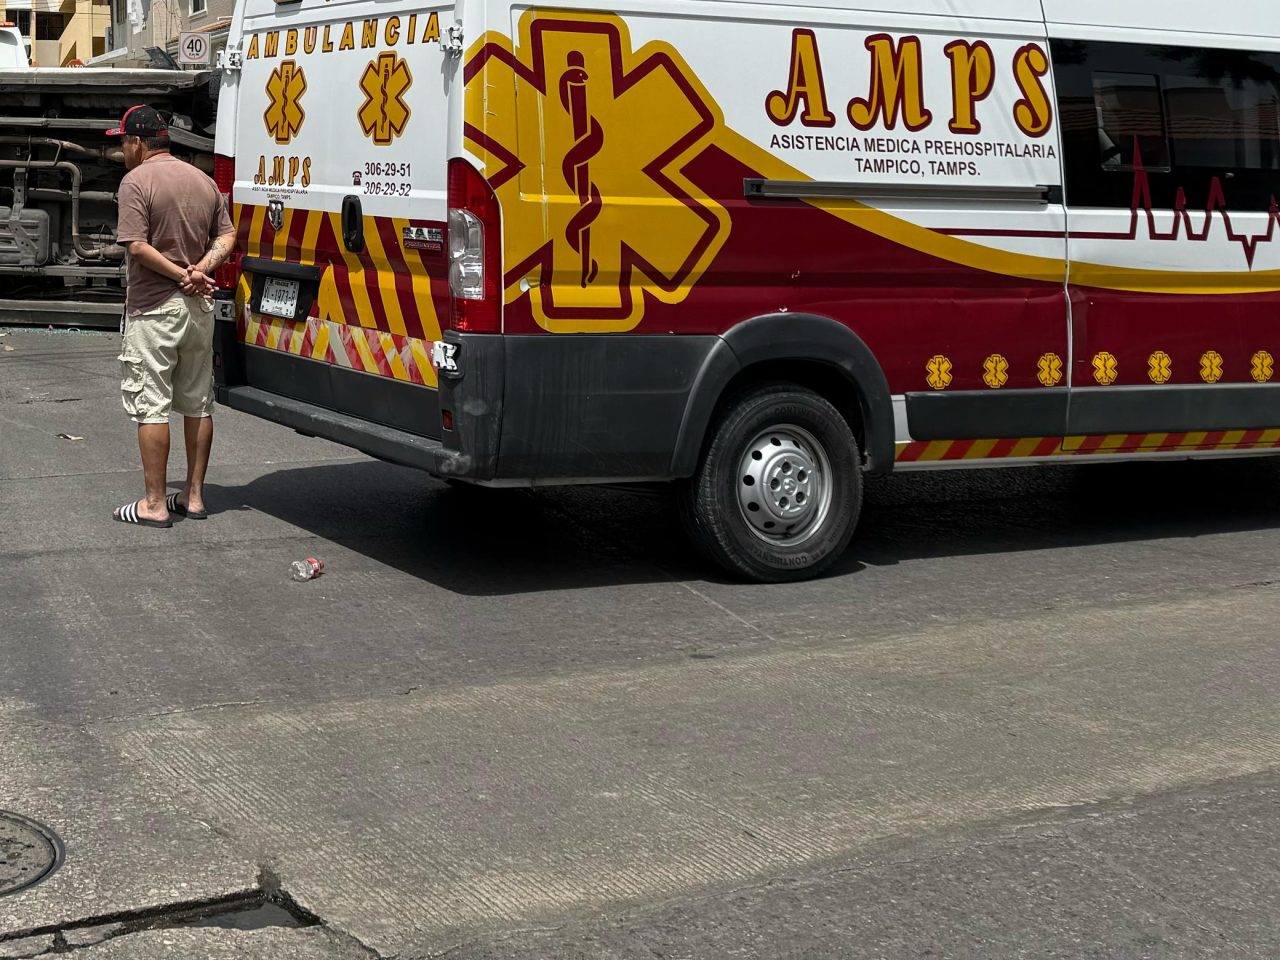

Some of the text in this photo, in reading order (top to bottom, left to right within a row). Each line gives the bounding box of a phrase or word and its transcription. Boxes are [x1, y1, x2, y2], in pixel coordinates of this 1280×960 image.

[187, 38, 201, 53] 40
[247, 11, 441, 60] AMBULANCIA
[764, 27, 1053, 138] AMPS
[770, 134, 1056, 159] ASISTENCIA MEDICA PREHOSPITALARIA
[254, 155, 312, 187] AMPS
[364, 162, 411, 178] 306-29-51
[855, 158, 981, 177] TAMPICO, TAMPS.
[363, 182, 412, 197] 306-29-52
